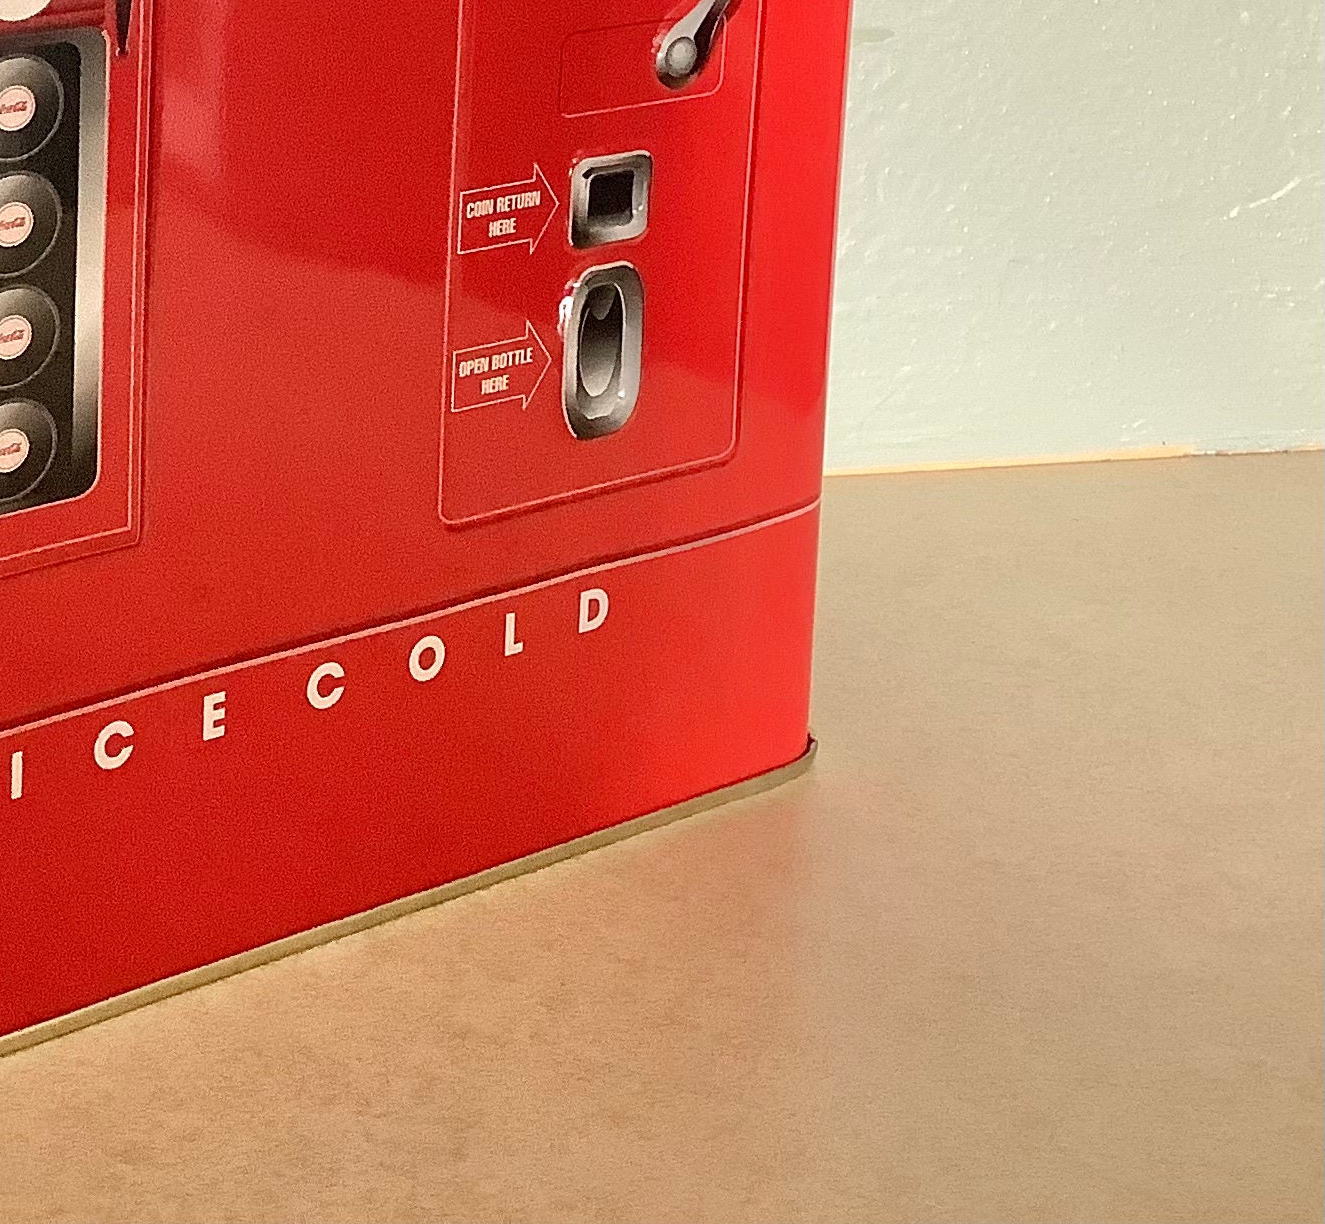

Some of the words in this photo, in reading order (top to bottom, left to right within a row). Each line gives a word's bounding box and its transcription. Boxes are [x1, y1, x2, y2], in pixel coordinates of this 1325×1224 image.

[466, 198, 494, 219] COIN
[496, 190, 541, 213] RETURN
[488, 217, 516, 238] HERE
[459, 356, 490, 378] OPEN
[491, 347, 534, 371] BOTTLE
[481, 374, 510, 395] HERE
[9, 690, 227, 800] ICE
[306, 588, 610, 710] COLD
